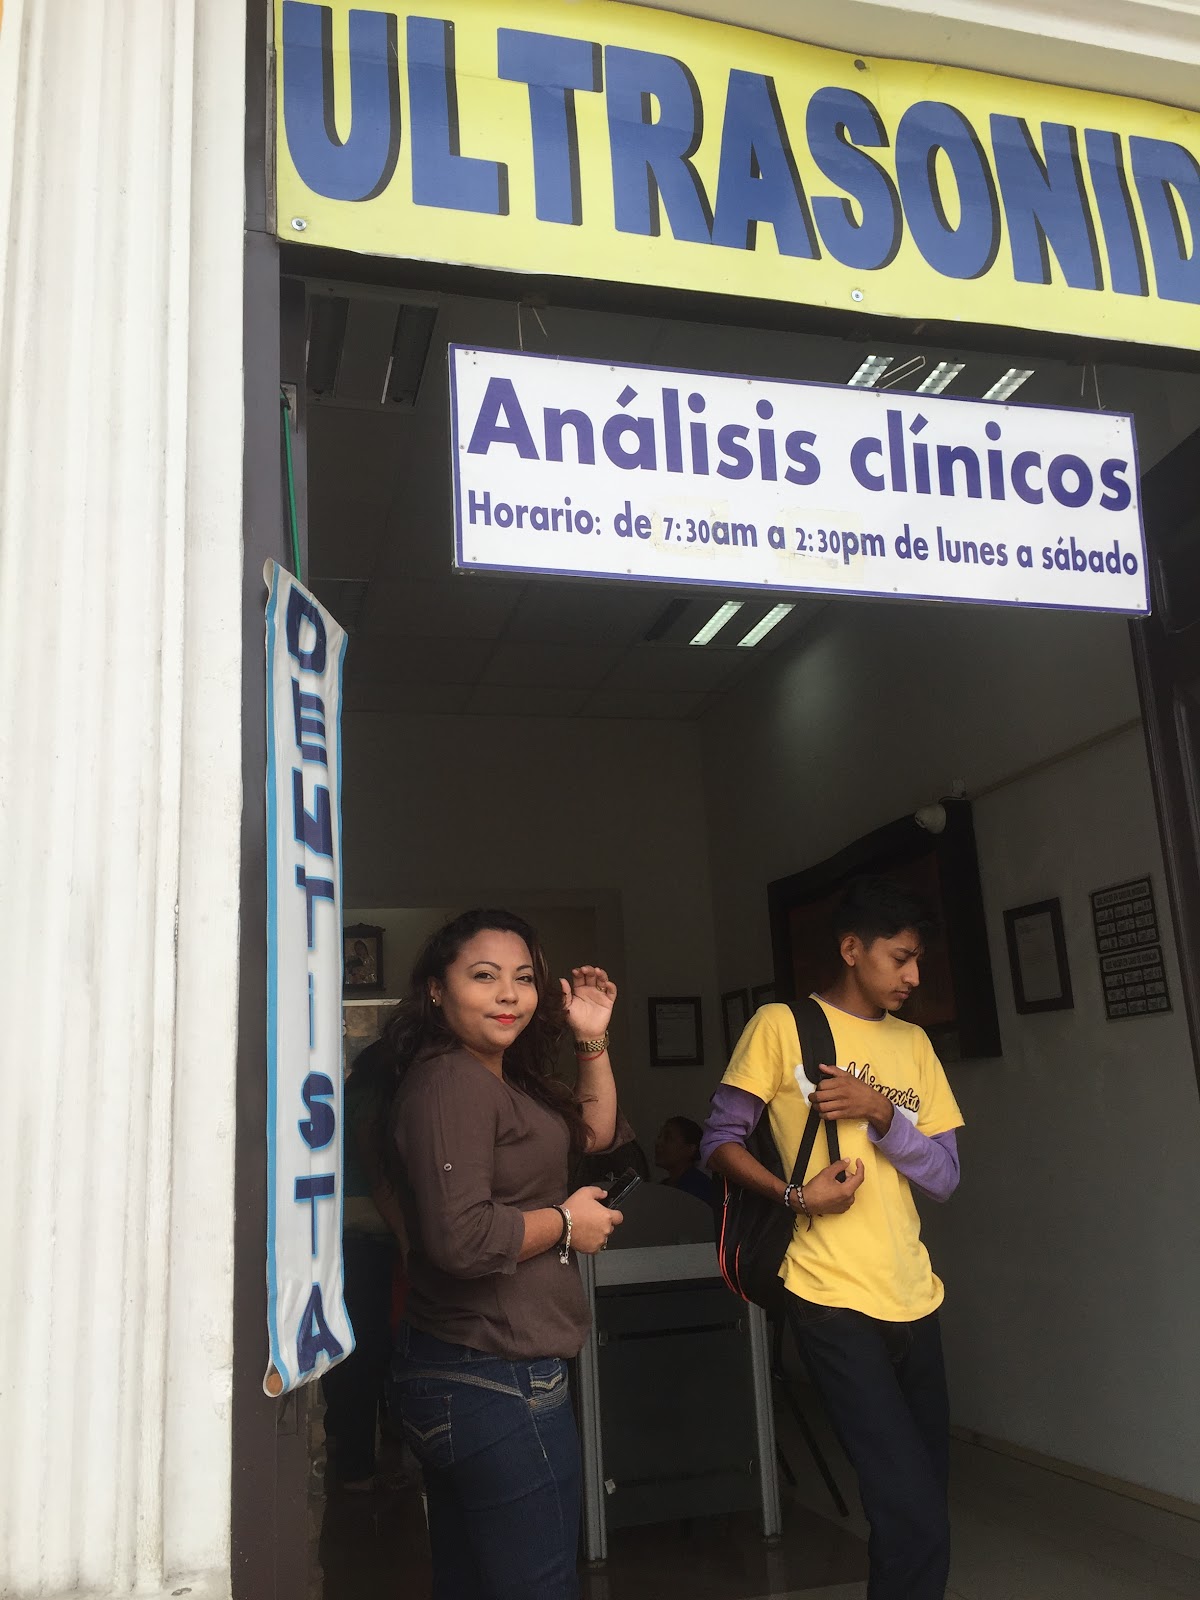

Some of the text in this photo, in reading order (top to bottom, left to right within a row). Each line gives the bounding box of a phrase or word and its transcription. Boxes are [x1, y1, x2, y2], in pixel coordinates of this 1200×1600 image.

[283, 0, 1200, 305] ULTRASONID
[467, 377, 1132, 512] Análisis clínicos
[468, 489, 1139, 576] Horario: de 7:30am a 2:30pm de lunes a sábado
[286, 581, 344, 1377] DENTISTA
